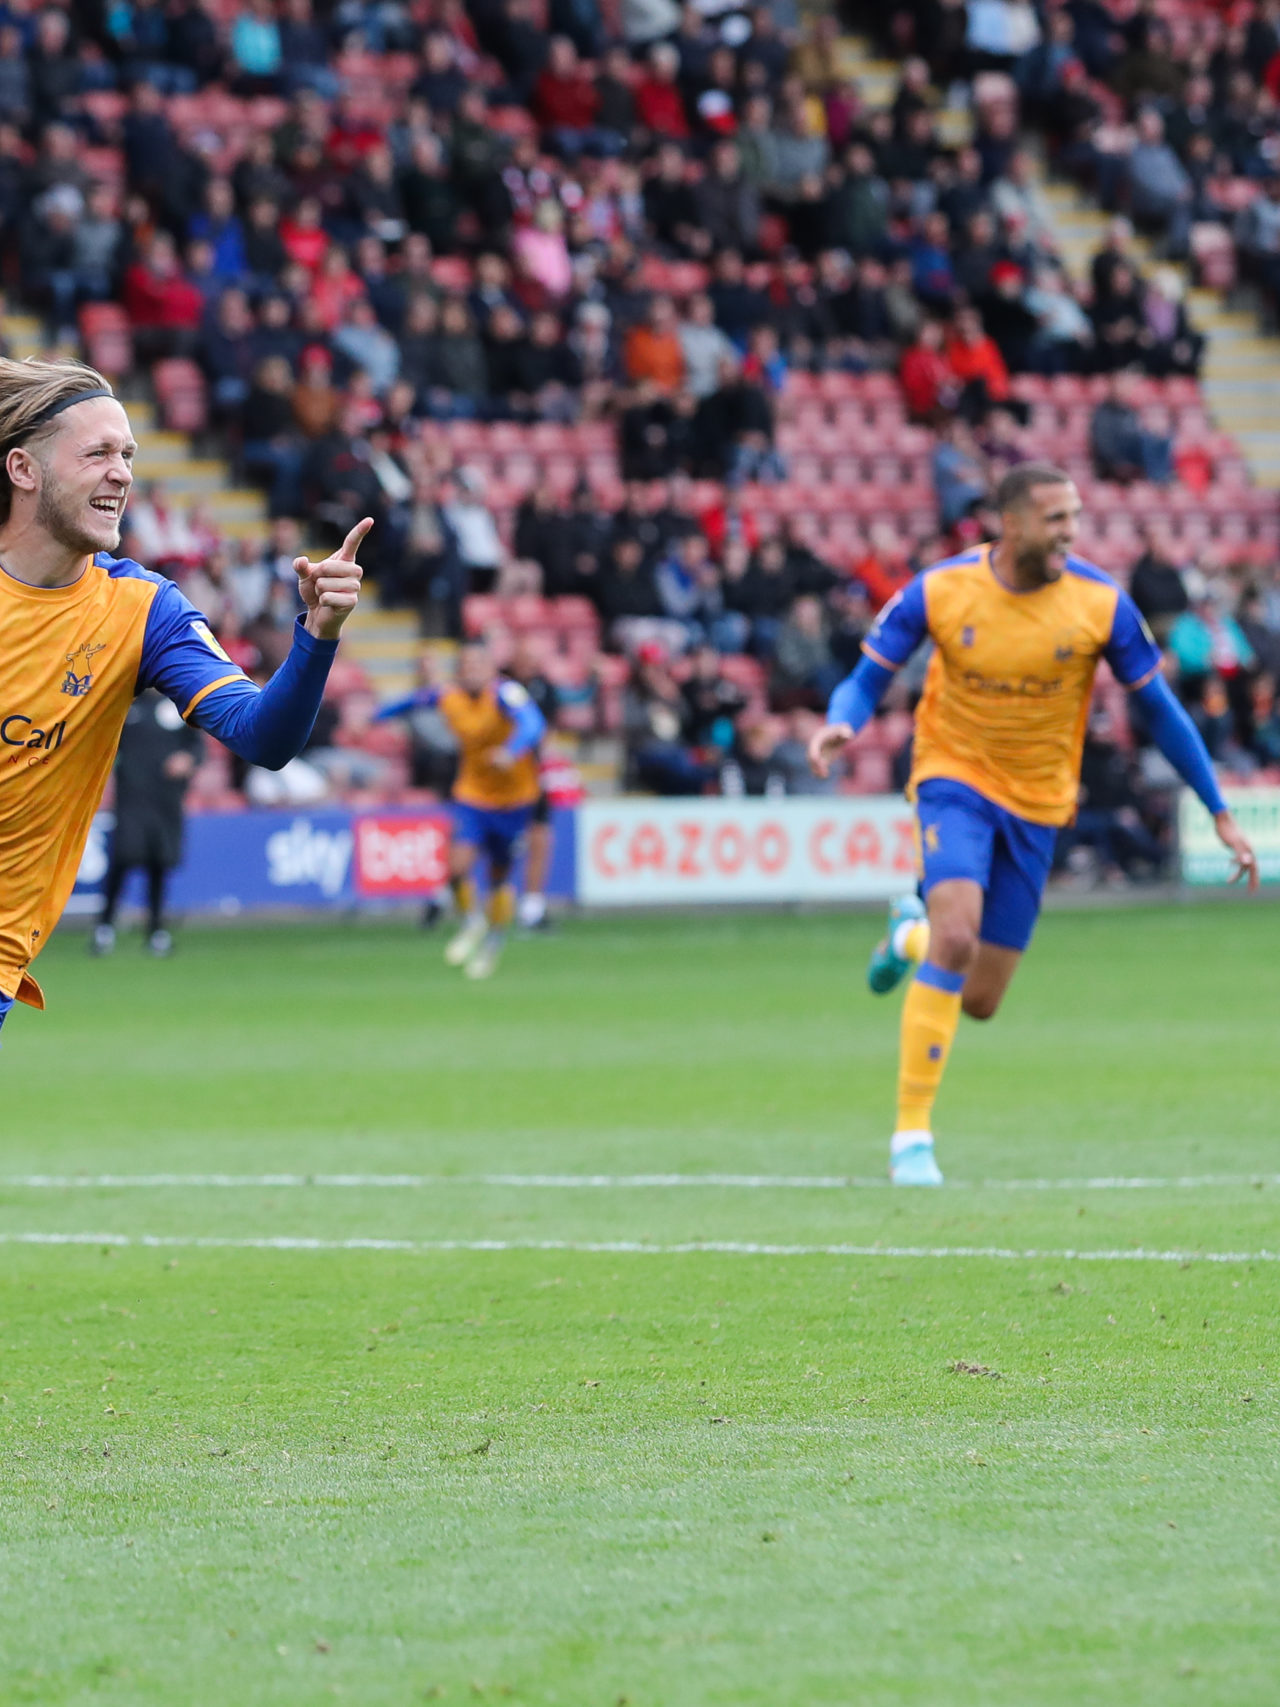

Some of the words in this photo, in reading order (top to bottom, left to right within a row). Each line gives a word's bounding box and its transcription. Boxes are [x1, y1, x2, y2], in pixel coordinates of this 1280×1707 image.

[0, 714, 67, 751] Call
[266, 817, 354, 894] sky
[360, 820, 446, 884] bet
[590, 820, 791, 877] CAZOO
